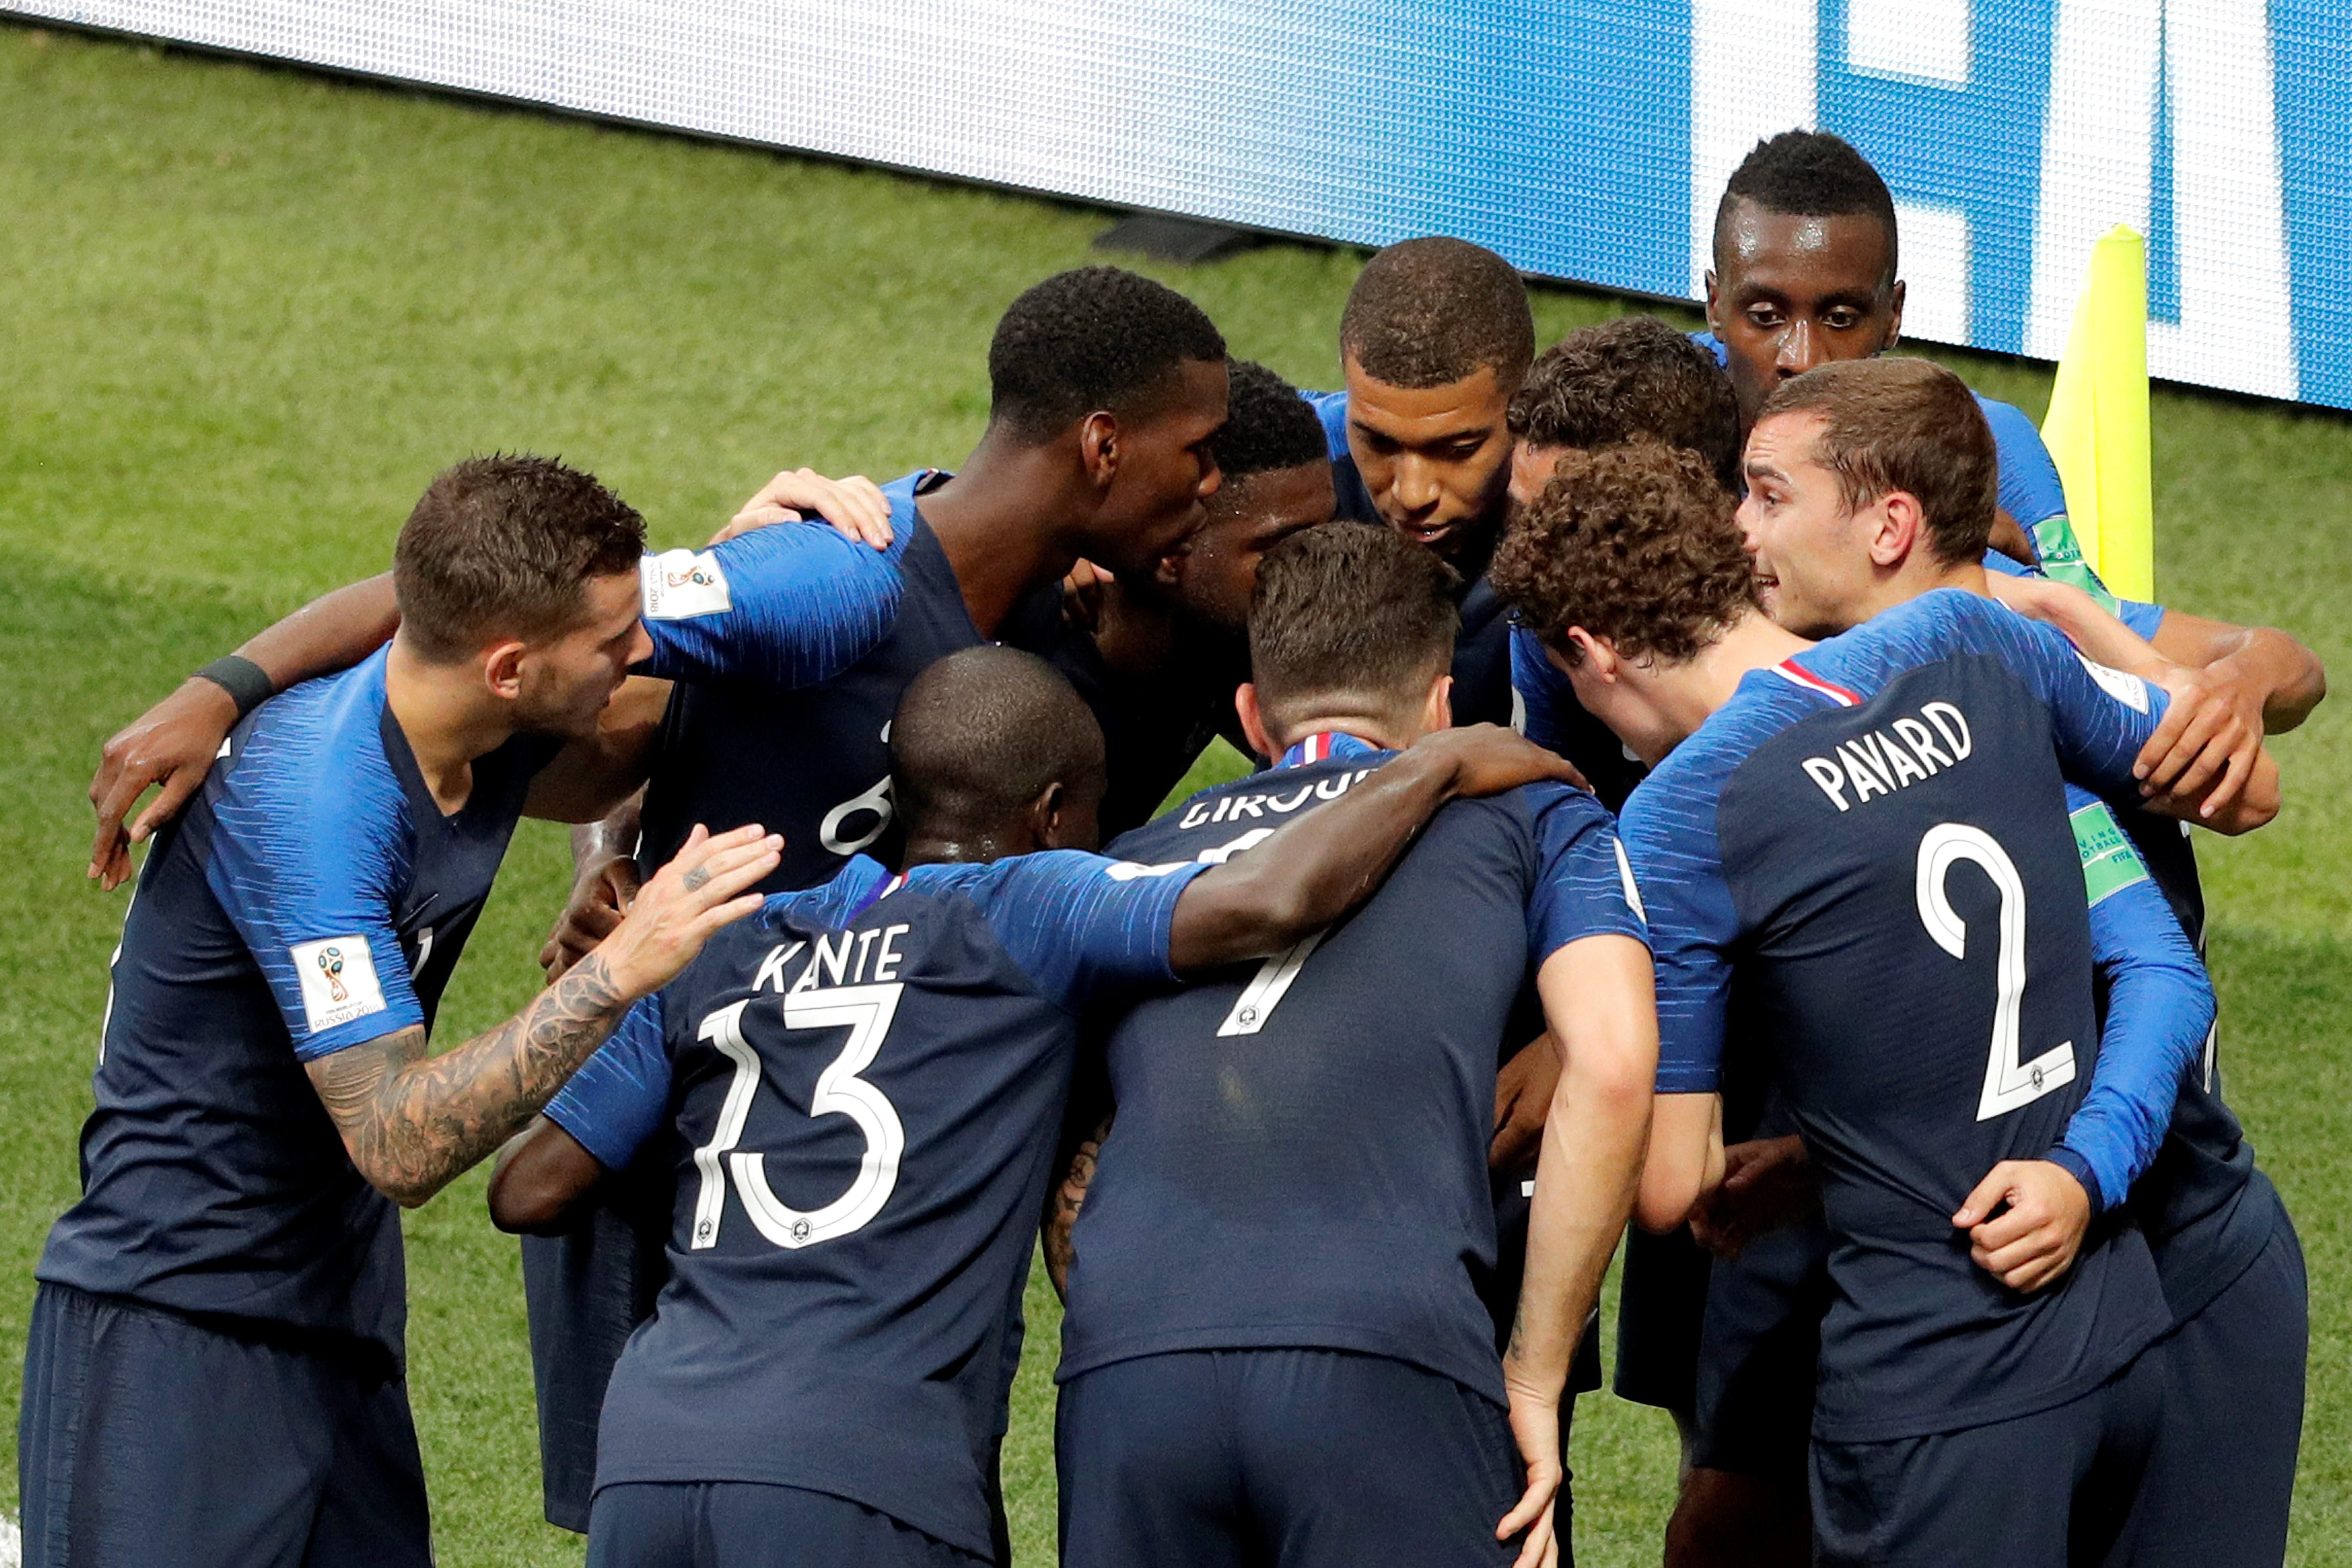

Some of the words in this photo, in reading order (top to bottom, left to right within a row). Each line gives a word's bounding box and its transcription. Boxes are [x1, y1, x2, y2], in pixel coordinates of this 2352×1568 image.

[650, 587, 659, 612] 2018
[1802, 701, 1972, 812] PAVARD
[1179, 768, 1378, 830] GIROU
[2079, 827, 2116, 848] VING
[2082, 836, 2122, 858] OTBALL
[2112, 850, 2132, 864] FIFA
[752, 924, 910, 994] KANTE
[1916, 822, 2076, 1121] 2
[315, 1011, 353, 1028] RUSSIA
[355, 1004, 380, 1018] 2018
[691, 982, 905, 1249] 13
